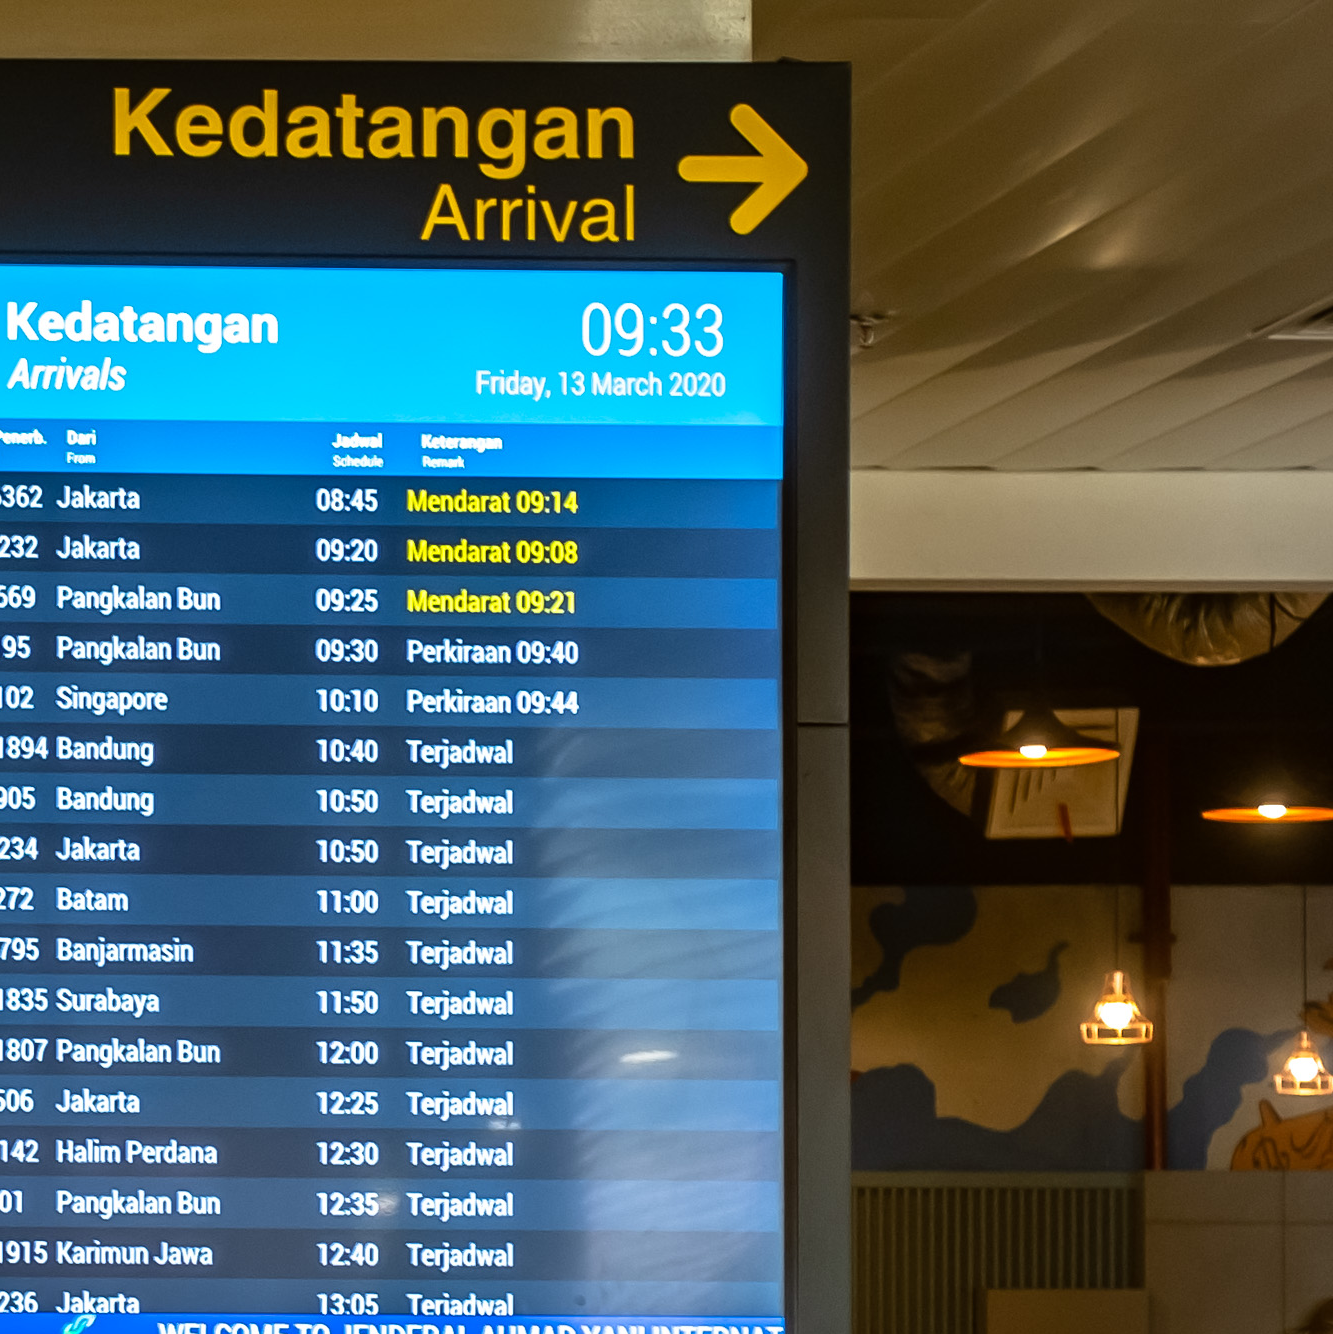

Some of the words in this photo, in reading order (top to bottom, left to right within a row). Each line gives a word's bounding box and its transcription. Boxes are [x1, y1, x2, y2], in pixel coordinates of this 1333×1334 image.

[114, 87, 634, 180] Kedatangan
[420, 183, 635, 243] Arrival
[6, 299, 279, 354] Kedatangan
[581, 301, 724, 358] 09:33
[6, 356, 128, 392] Arrivals
[475, 369, 552, 402] Friday,
[558, 370, 586, 397] 13
[591, 371, 663, 397] March
[669, 371, 726, 398] 2020
[66, 429, 97, 446] Dari
[331, 432, 383, 449] Jadwal
[420, 433, 503, 454] Keterangan
[66, 451, 96, 465] From
[332, 454, 384, 468] Schedule
[422, 455, 465, 469] Remark
[56, 484, 141, 510] Jakarta
[316, 487, 379, 512] 08:45
[407, 488, 512, 514] Mendarat
[516, 490, 579, 514] 09:14
[56, 684, 169, 716] Singapore
[316, 688, 379, 713] 10:10
[407, 688, 512, 714] Perkiraan
[516, 690, 580, 715] 09:44
[57, 937, 194, 967] Banjarmasin
[316, 940, 379, 964] 11:35
[406, 939, 513, 971] Terjadwal
[55, 1088, 140, 1113] Jakarta
[316, 1091, 379, 1115] 12:25
[405, 1090, 514, 1122] Terjadwal
